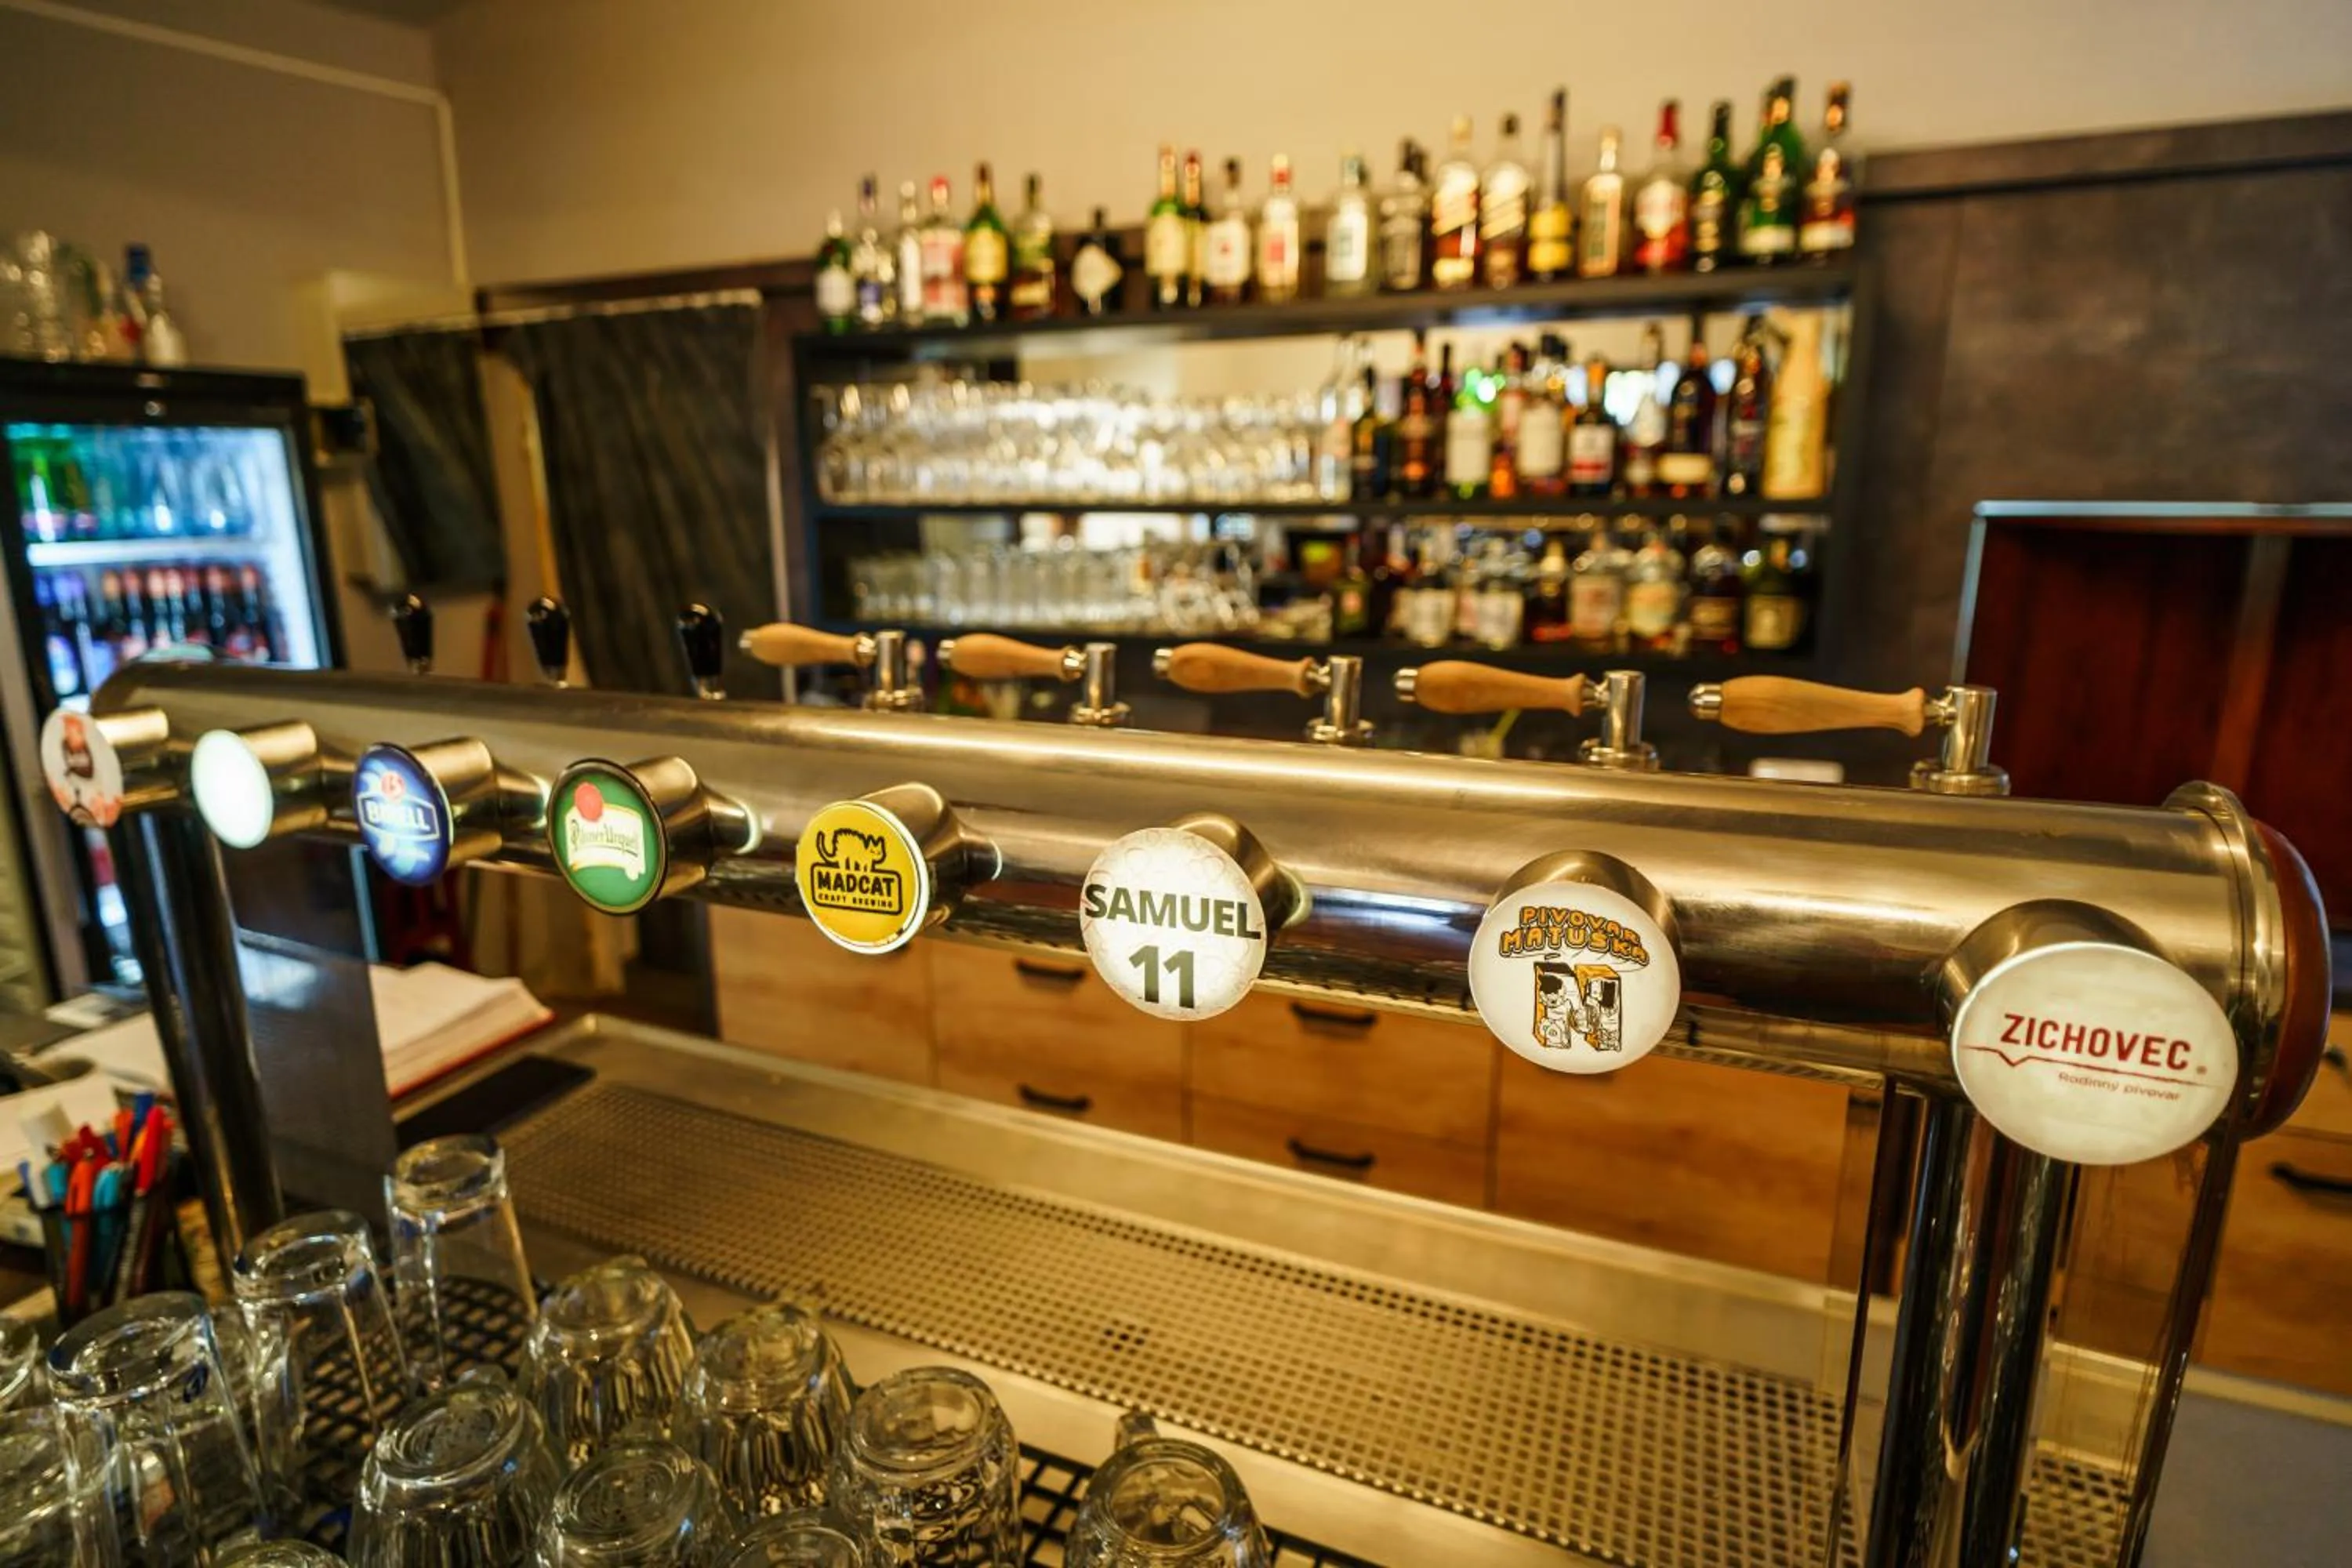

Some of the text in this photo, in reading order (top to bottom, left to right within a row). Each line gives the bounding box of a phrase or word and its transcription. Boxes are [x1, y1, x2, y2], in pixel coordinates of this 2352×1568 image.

[365, 800, 430, 832] BELL
[817, 869, 895, 897] MADCAT
[818, 892, 893, 909] CRAFT BREWING
[1084, 884, 1261, 940] SAMUEL
[1519, 906, 1642, 945] PIVOVAR
[1128, 945, 1195, 1009] 11
[2000, 1013, 2191, 1071] ZICHOVEC
[2123, 1083, 2182, 1101] pivovar
